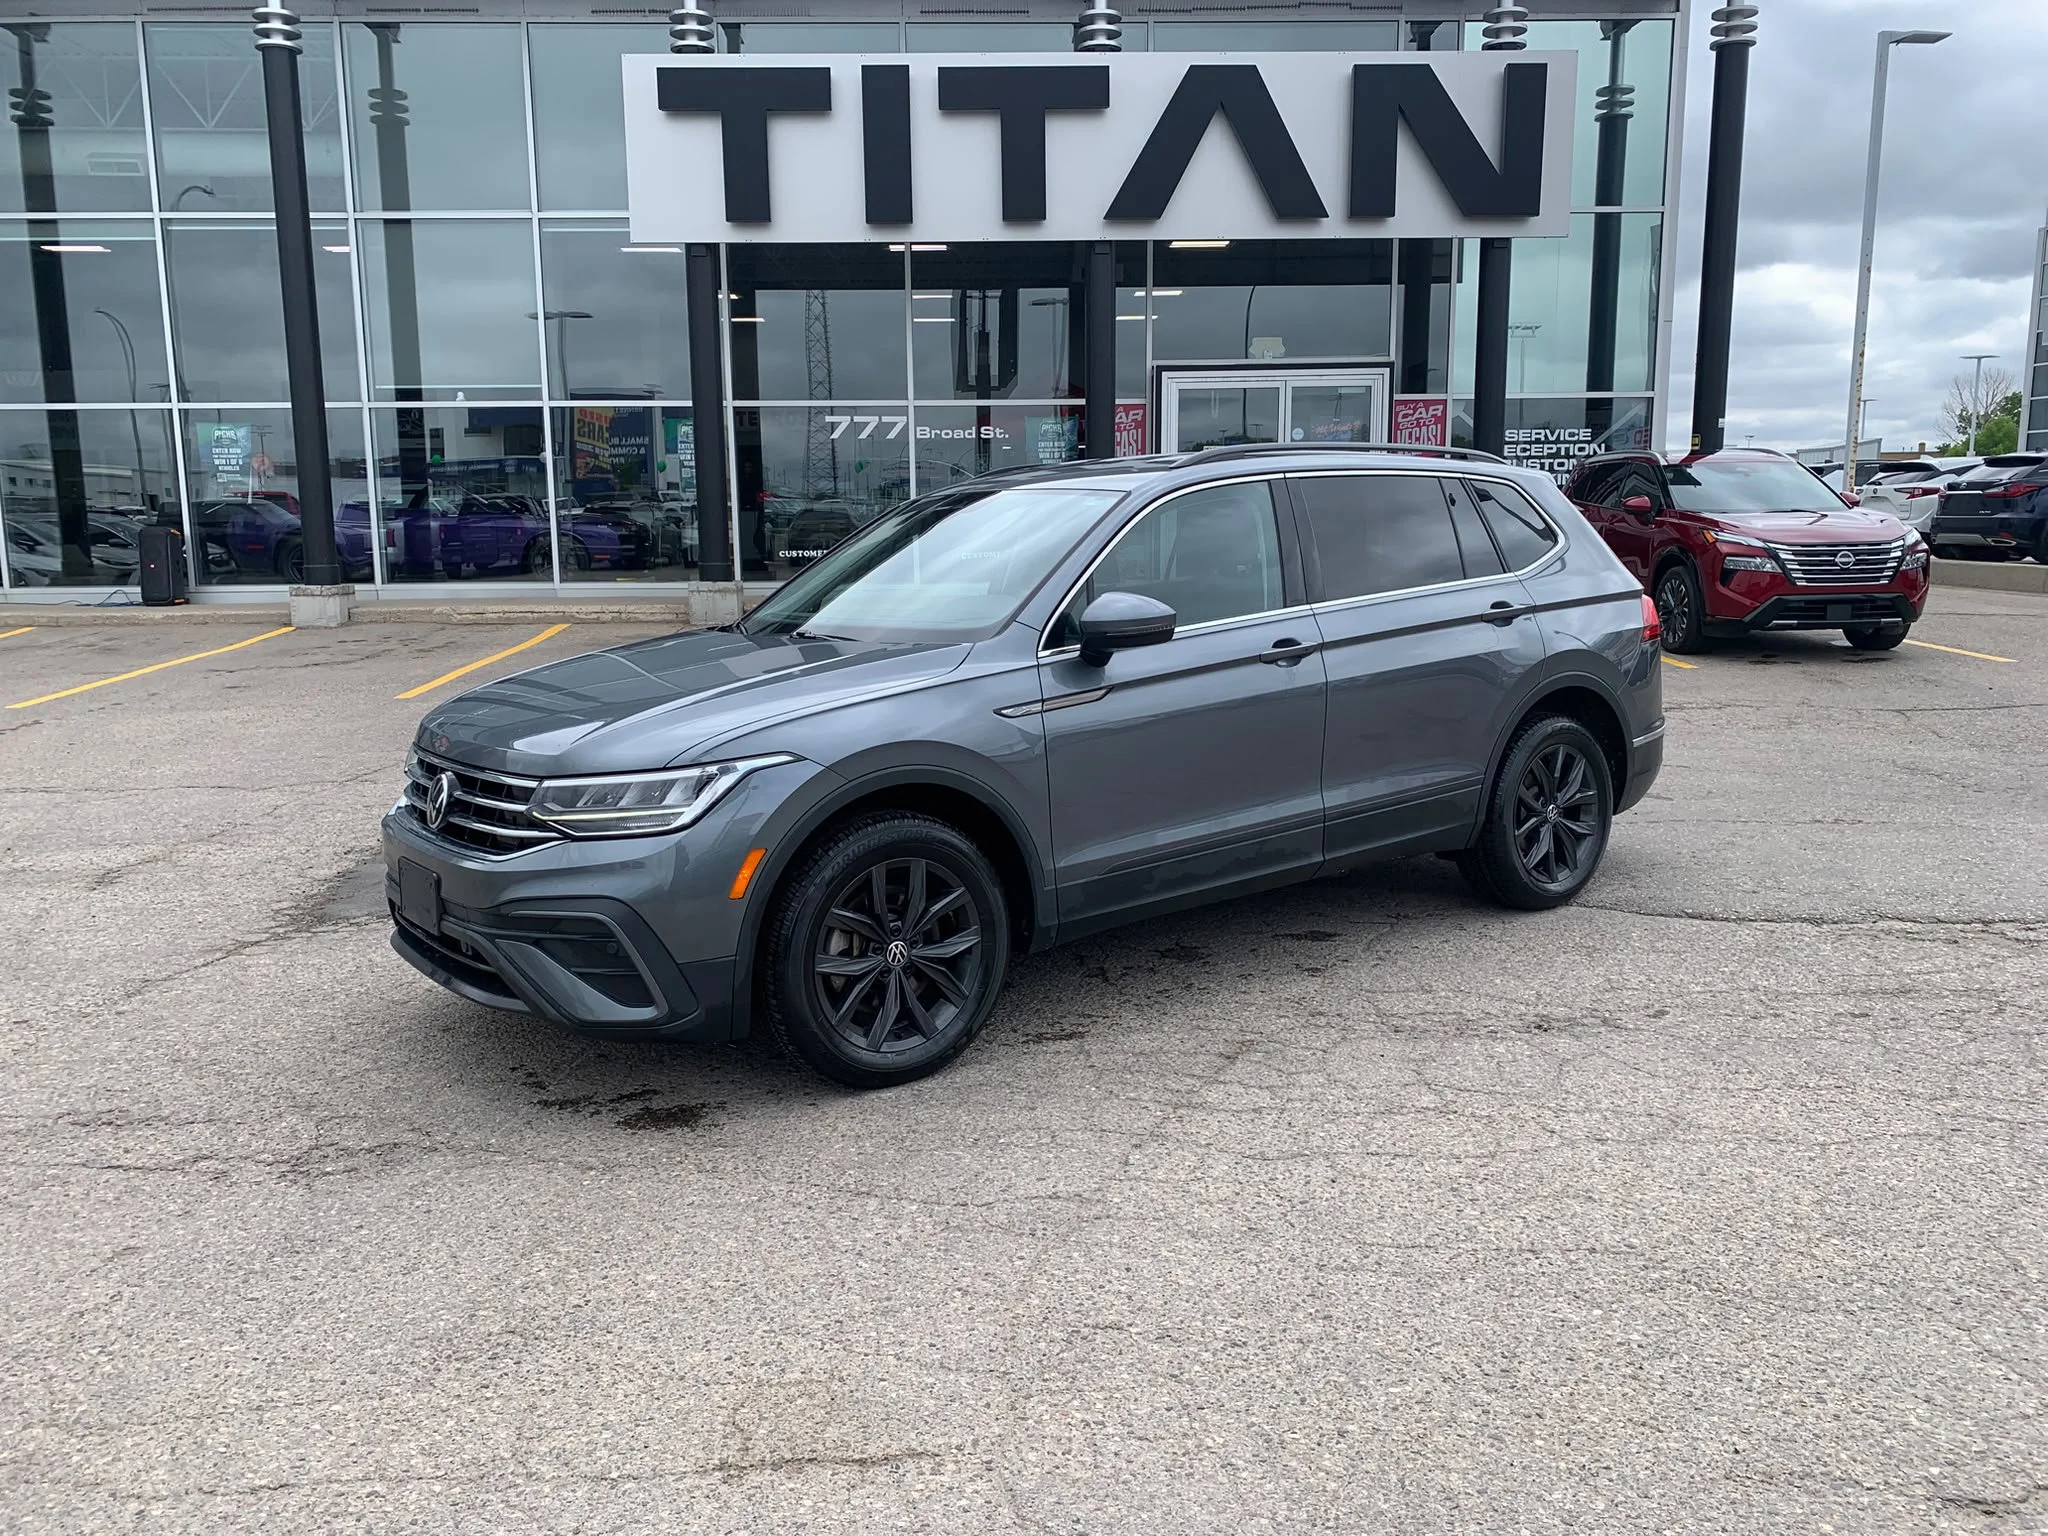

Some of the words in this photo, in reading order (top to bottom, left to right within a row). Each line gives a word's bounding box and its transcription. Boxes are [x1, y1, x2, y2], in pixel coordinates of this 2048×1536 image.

[656, 64, 1548, 224] TITAN
[1395, 402, 1416, 411] BUY
[1397, 404, 1444, 423] CAR
[1115, 409, 1144, 424] AR
[1399, 420, 1417, 430] GO
[1418, 417, 1435, 426] TO
[825, 416, 907, 439] 777
[916, 427, 976, 439] Broad
[980, 427, 1009, 439] St.
[1504, 428, 1592, 442] SERVICE
[1503, 443, 1605, 456] ECEPTION
